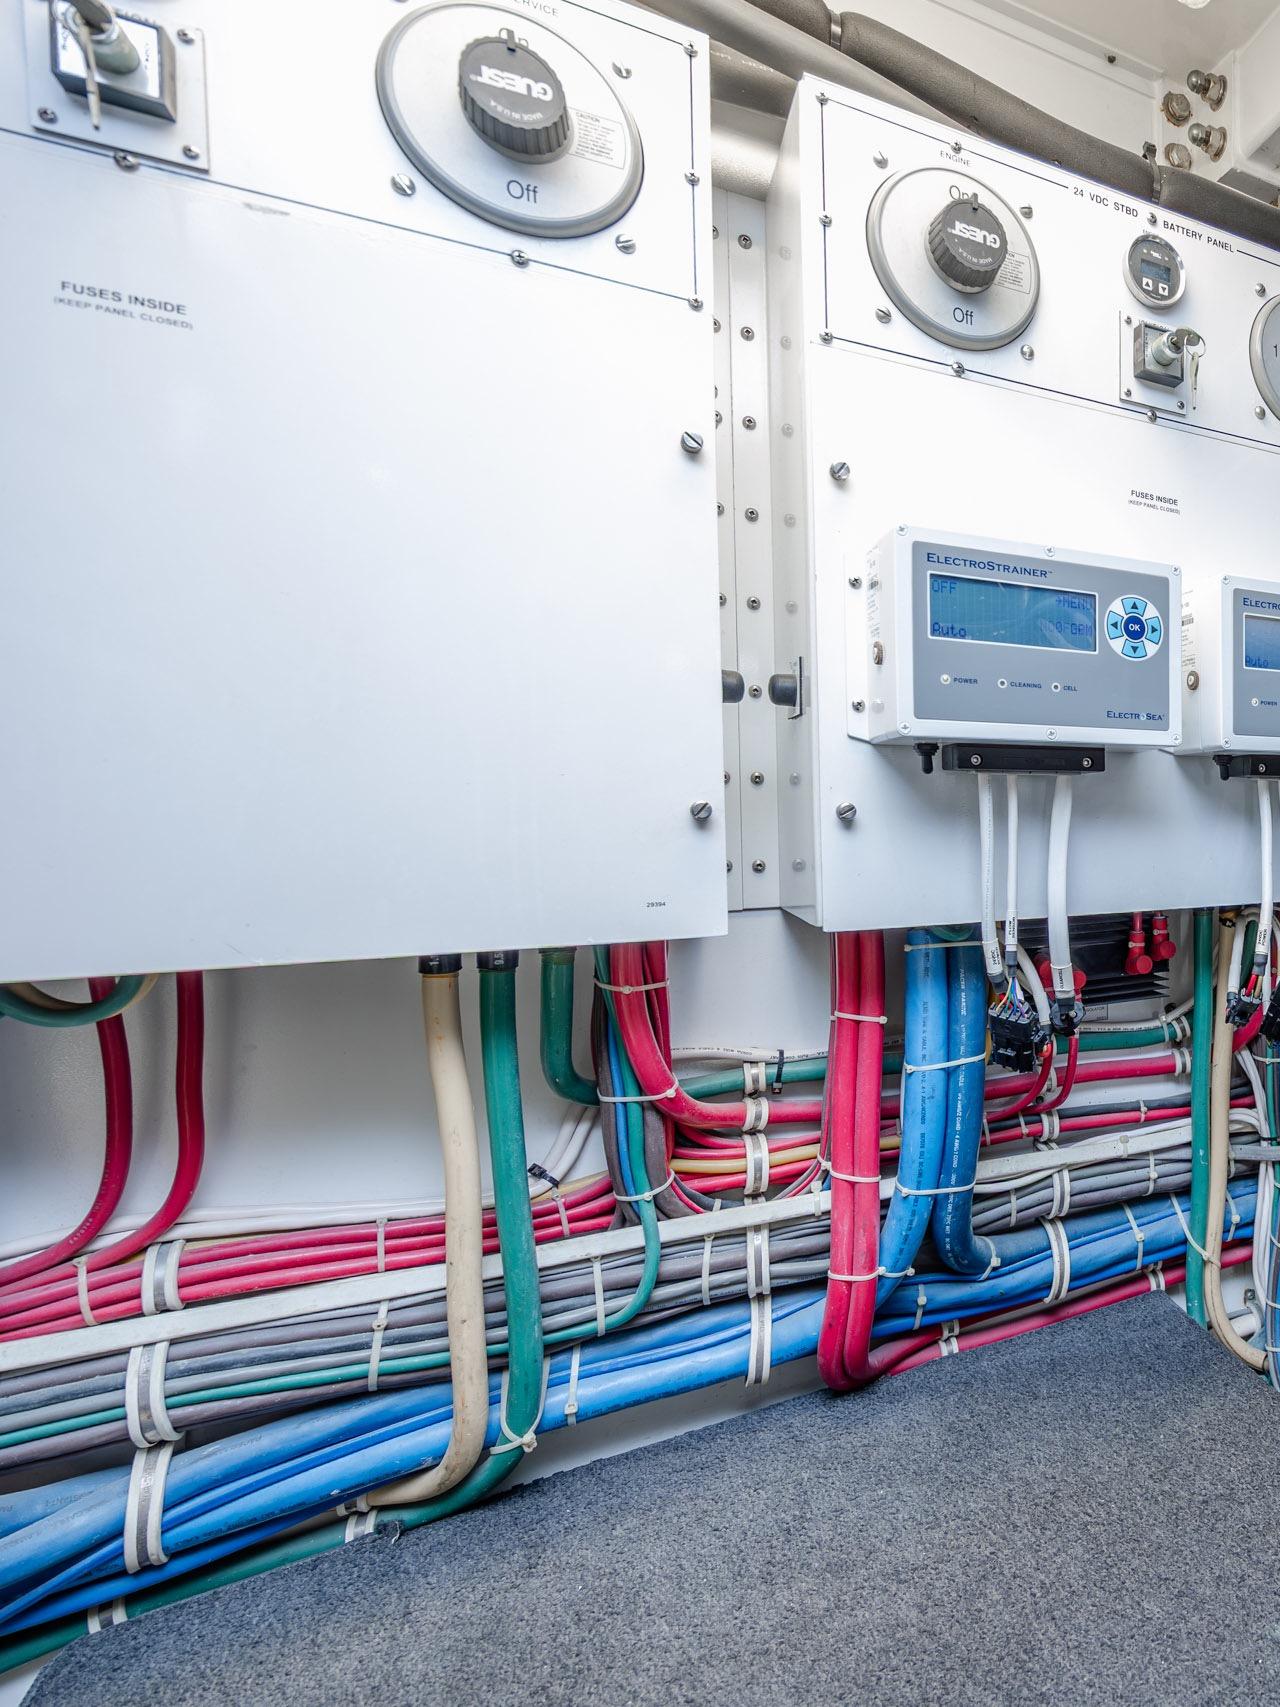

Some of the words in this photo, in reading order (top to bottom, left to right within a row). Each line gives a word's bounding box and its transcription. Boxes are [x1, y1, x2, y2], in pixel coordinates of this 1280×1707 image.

[940, 150, 972, 168] ENGINE
[506, 180, 539, 204] Off
[1073, 186, 1085, 198] 24
[1089, 192, 1110, 207] VDC
[1113, 201, 1139, 218] STBD
[1163, 220, 1203, 242] BATTERY
[1207, 236, 1235, 254] PANEL
[60, 280, 123, 303] FUSES
[127, 294, 188, 316] INSIDE
[94, 303, 136, 319] PANEL
[952, 307, 974, 326] Off
[1272, 343, 1279, 358] 1
[1130, 489, 1155, 501] FUSES
[1155, 495, 1179, 506] INSIDE
[1143, 502, 1159, 511] PANEL
[931, 579, 958, 594] OFF
[932, 622, 968, 638] Auto
[1127, 623, 1142, 632] OK
[953, 677, 979, 685] POWER
[1009, 681, 1042, 689] CLEANING
